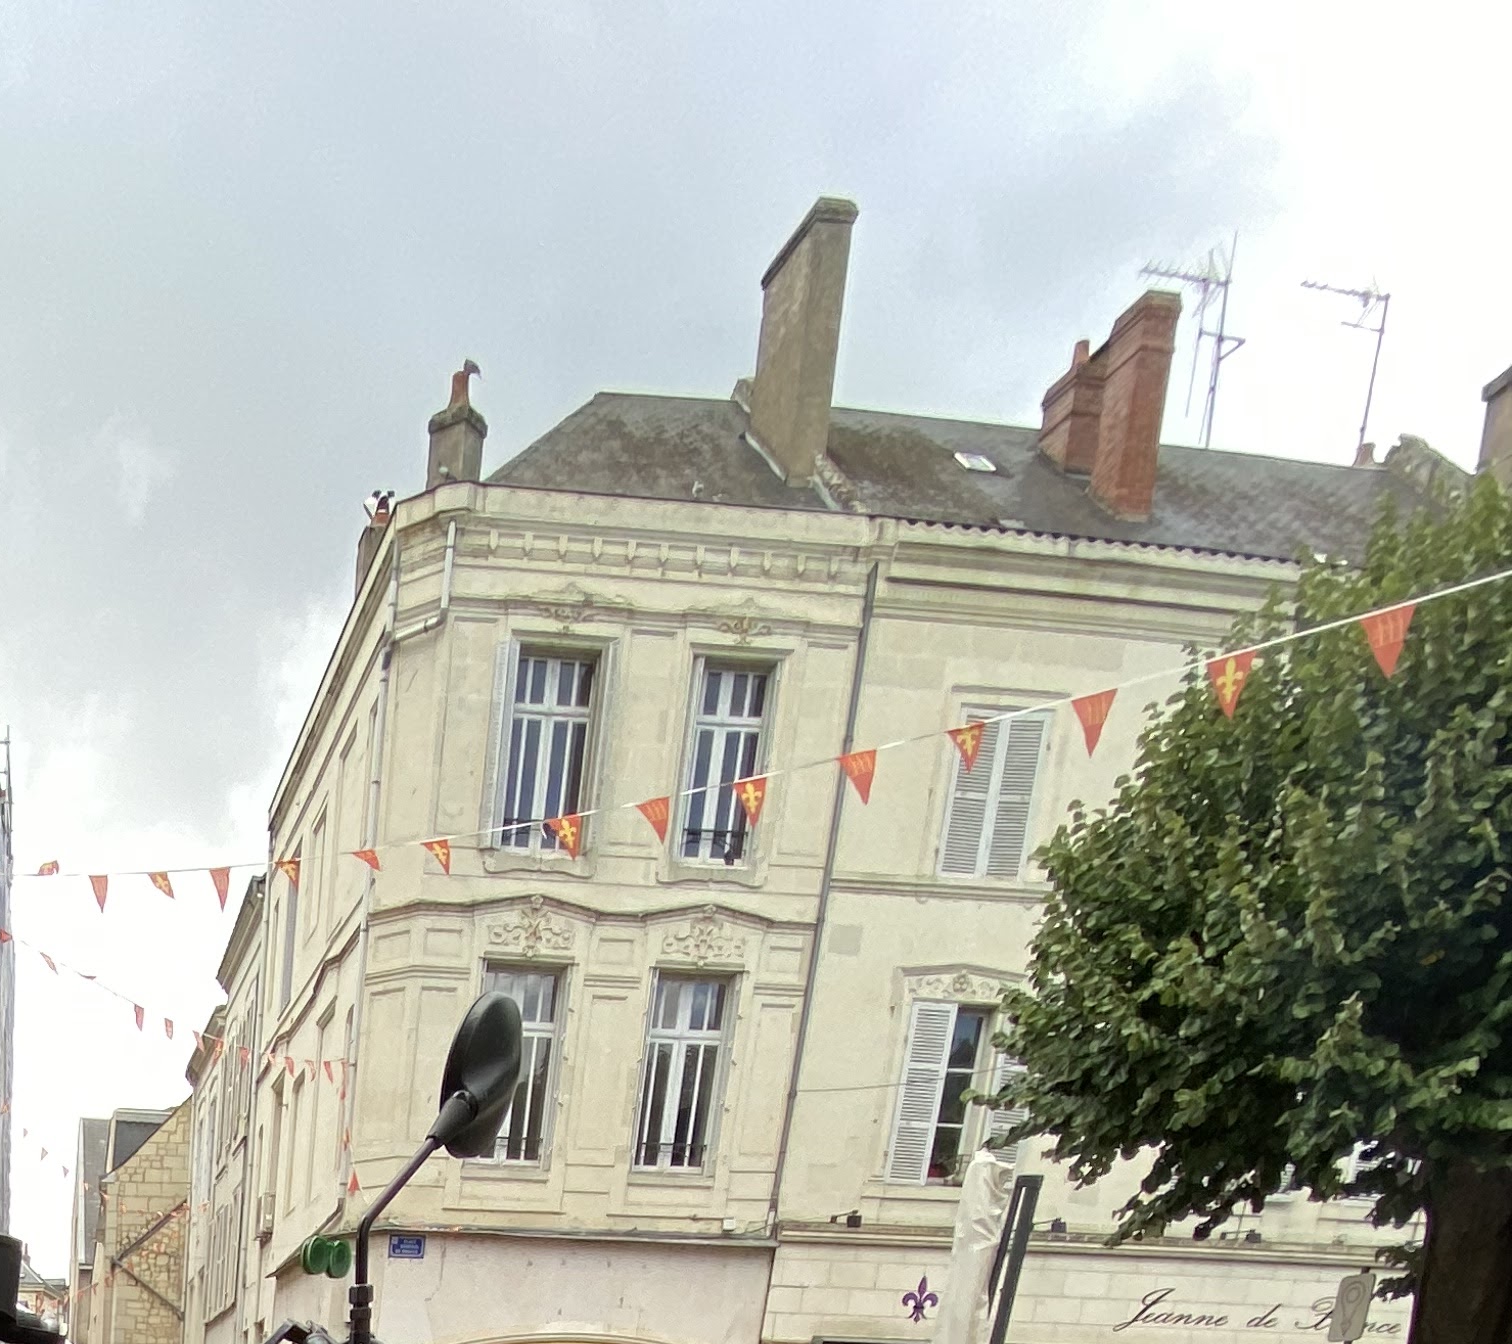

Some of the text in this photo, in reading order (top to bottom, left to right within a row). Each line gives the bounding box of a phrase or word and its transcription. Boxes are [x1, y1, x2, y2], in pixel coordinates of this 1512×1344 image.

[1112, 1288, 1402, 1334] Jeanne de Fnce
